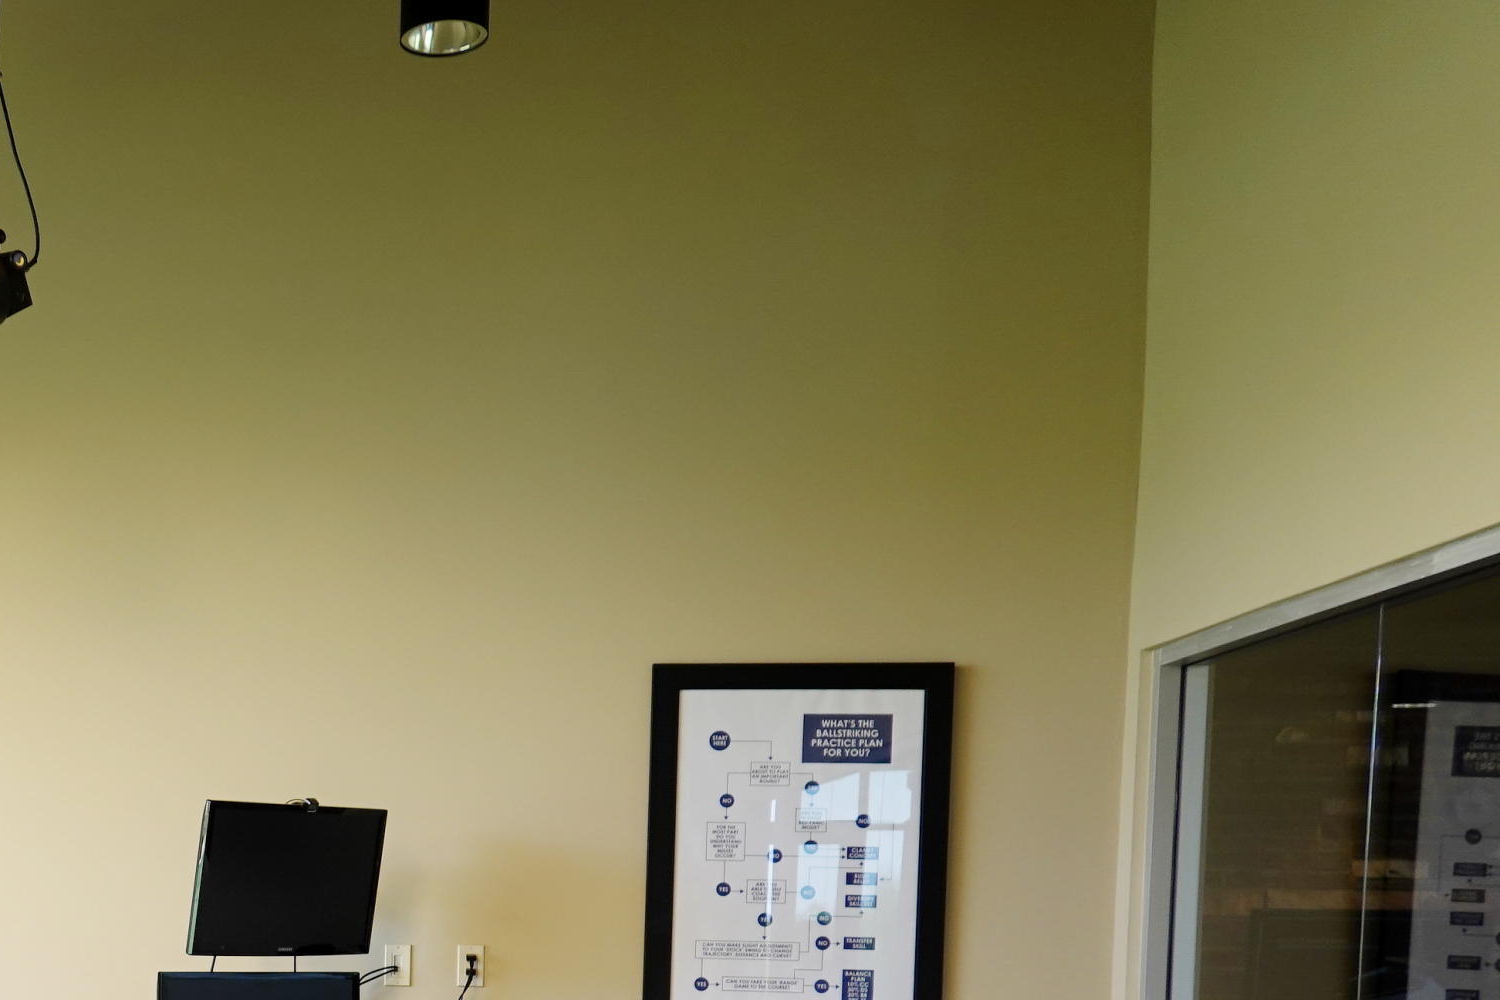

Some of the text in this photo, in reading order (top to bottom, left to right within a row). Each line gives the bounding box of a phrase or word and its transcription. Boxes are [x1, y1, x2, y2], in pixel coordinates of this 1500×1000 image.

[821, 719, 875, 728] WHAT'S THE
[816, 729, 879, 738] BALLSTRIKING
[811, 738, 884, 747] PRACTICE PLAN
[823, 748, 871, 757] FOR YOU?
